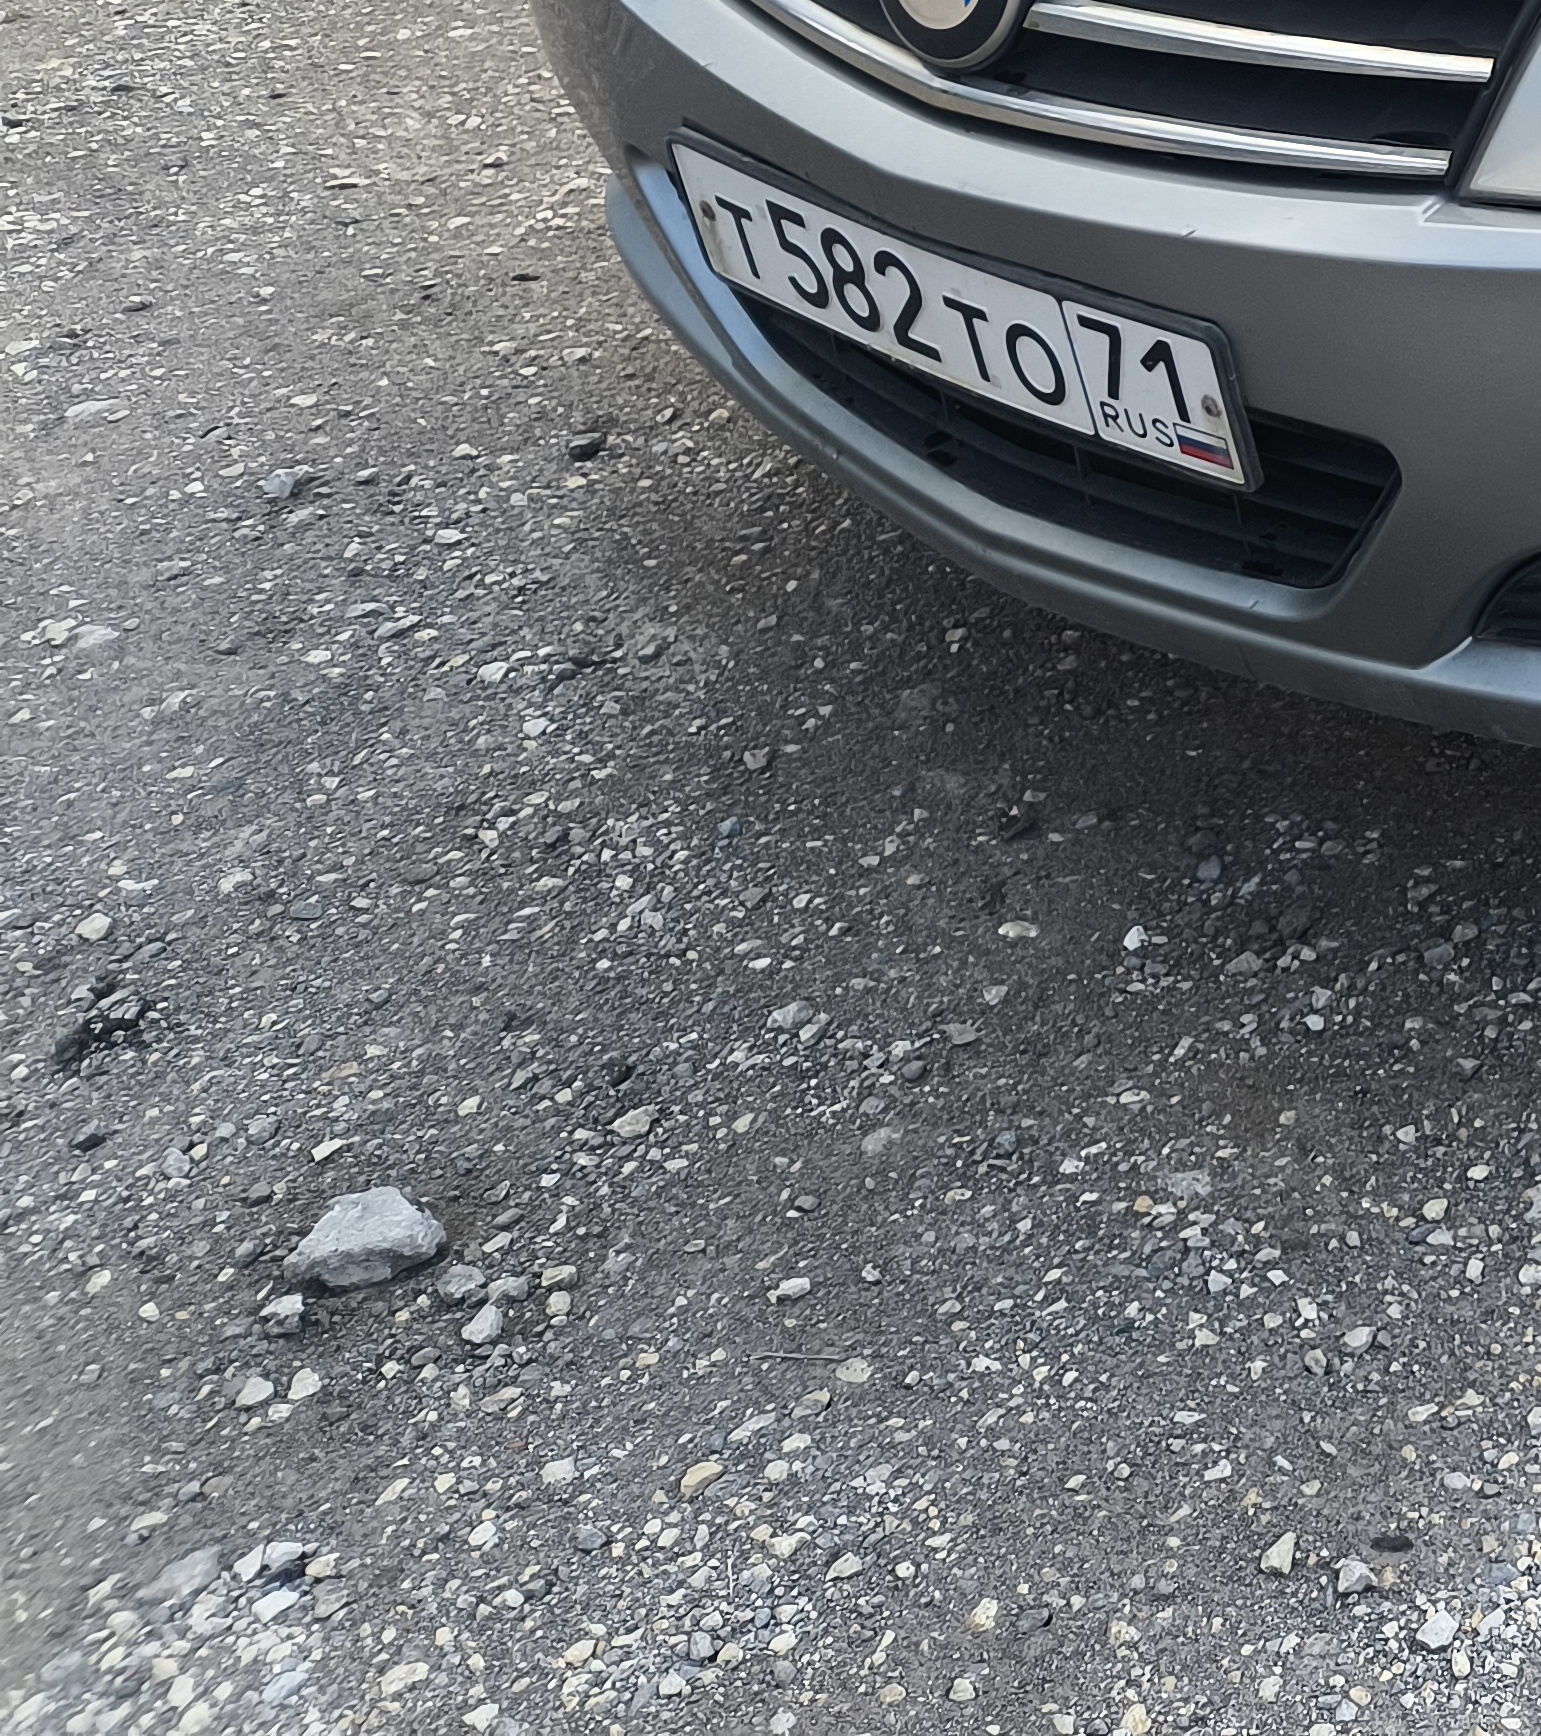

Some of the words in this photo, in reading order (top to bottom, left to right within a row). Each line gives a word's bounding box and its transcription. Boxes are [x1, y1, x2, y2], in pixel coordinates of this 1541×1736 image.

[713, 193, 1067, 406] Т582ТО
[1077, 313, 1191, 423] 71
[1100, 400, 1176, 448] RUS
